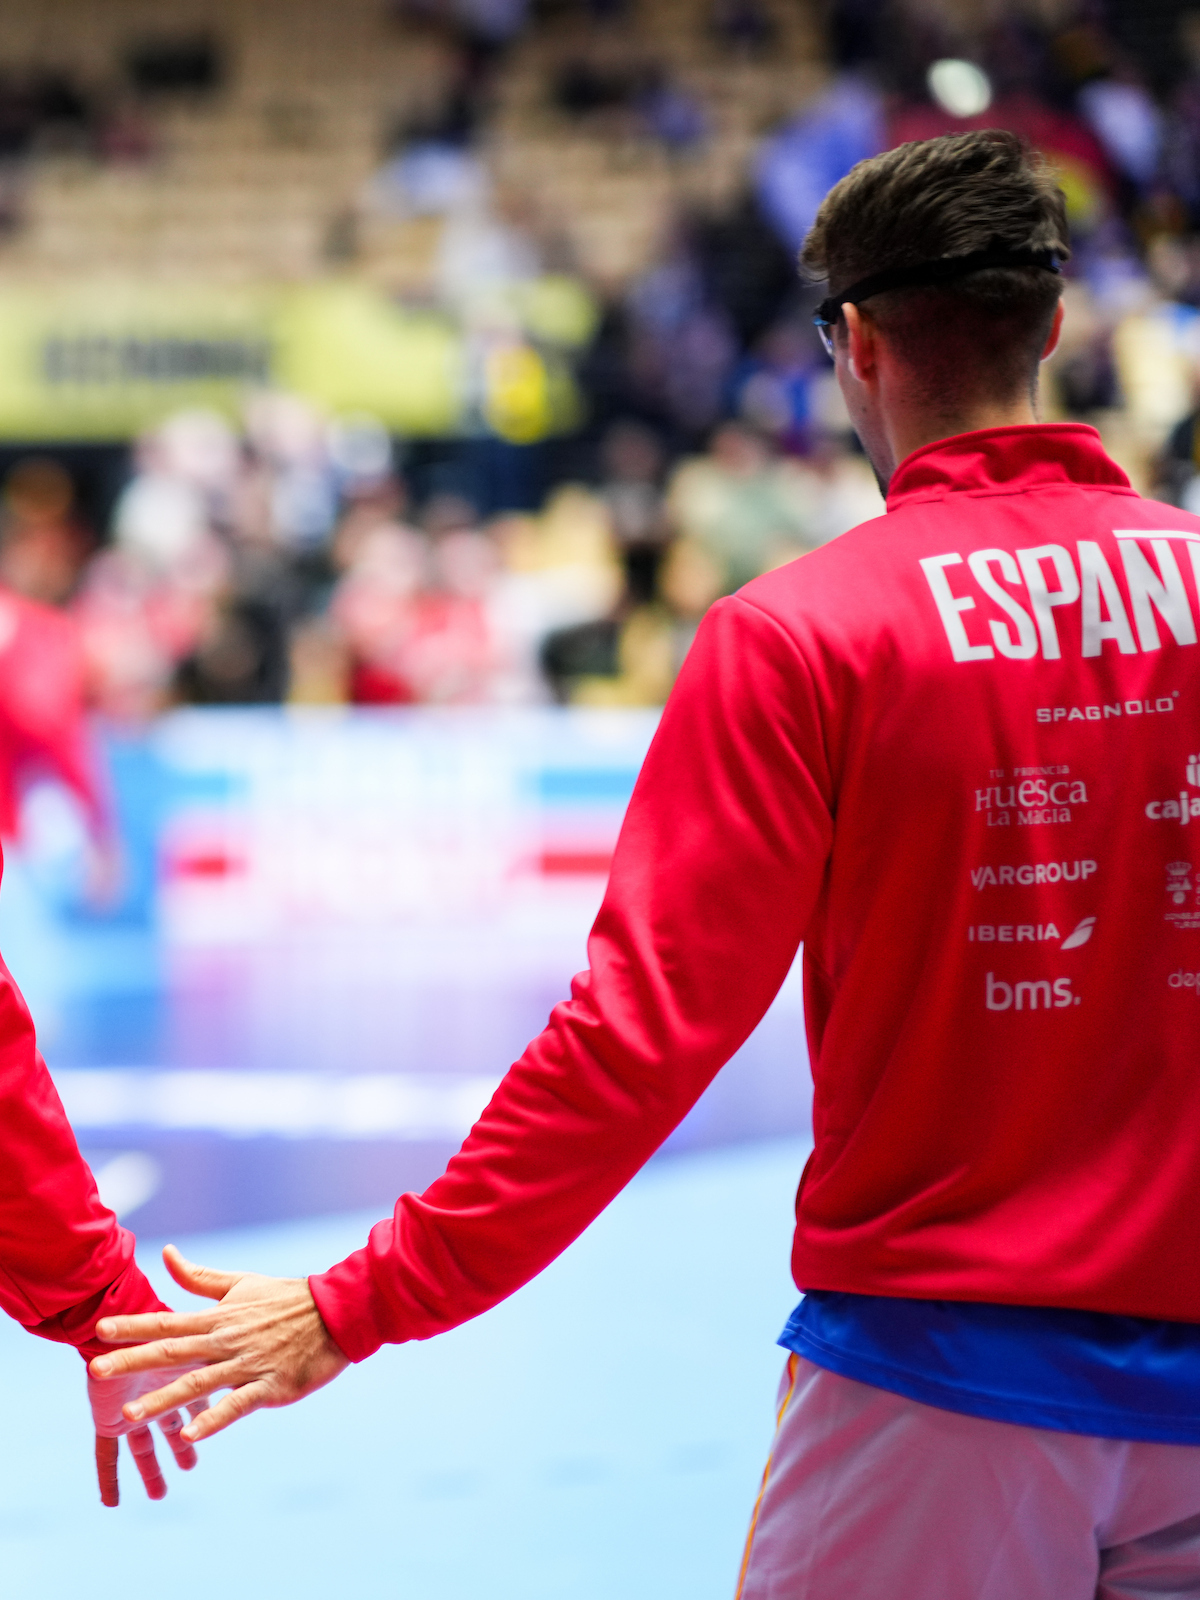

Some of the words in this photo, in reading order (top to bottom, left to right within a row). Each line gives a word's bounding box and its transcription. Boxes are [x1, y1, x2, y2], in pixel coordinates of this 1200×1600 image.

[1036, 697, 1174, 723] SPAGNOLO
[971, 860, 1098, 890] VARGROUP
[969, 923, 1061, 943] IBERIA
[986, 971, 1082, 1011] bms.
